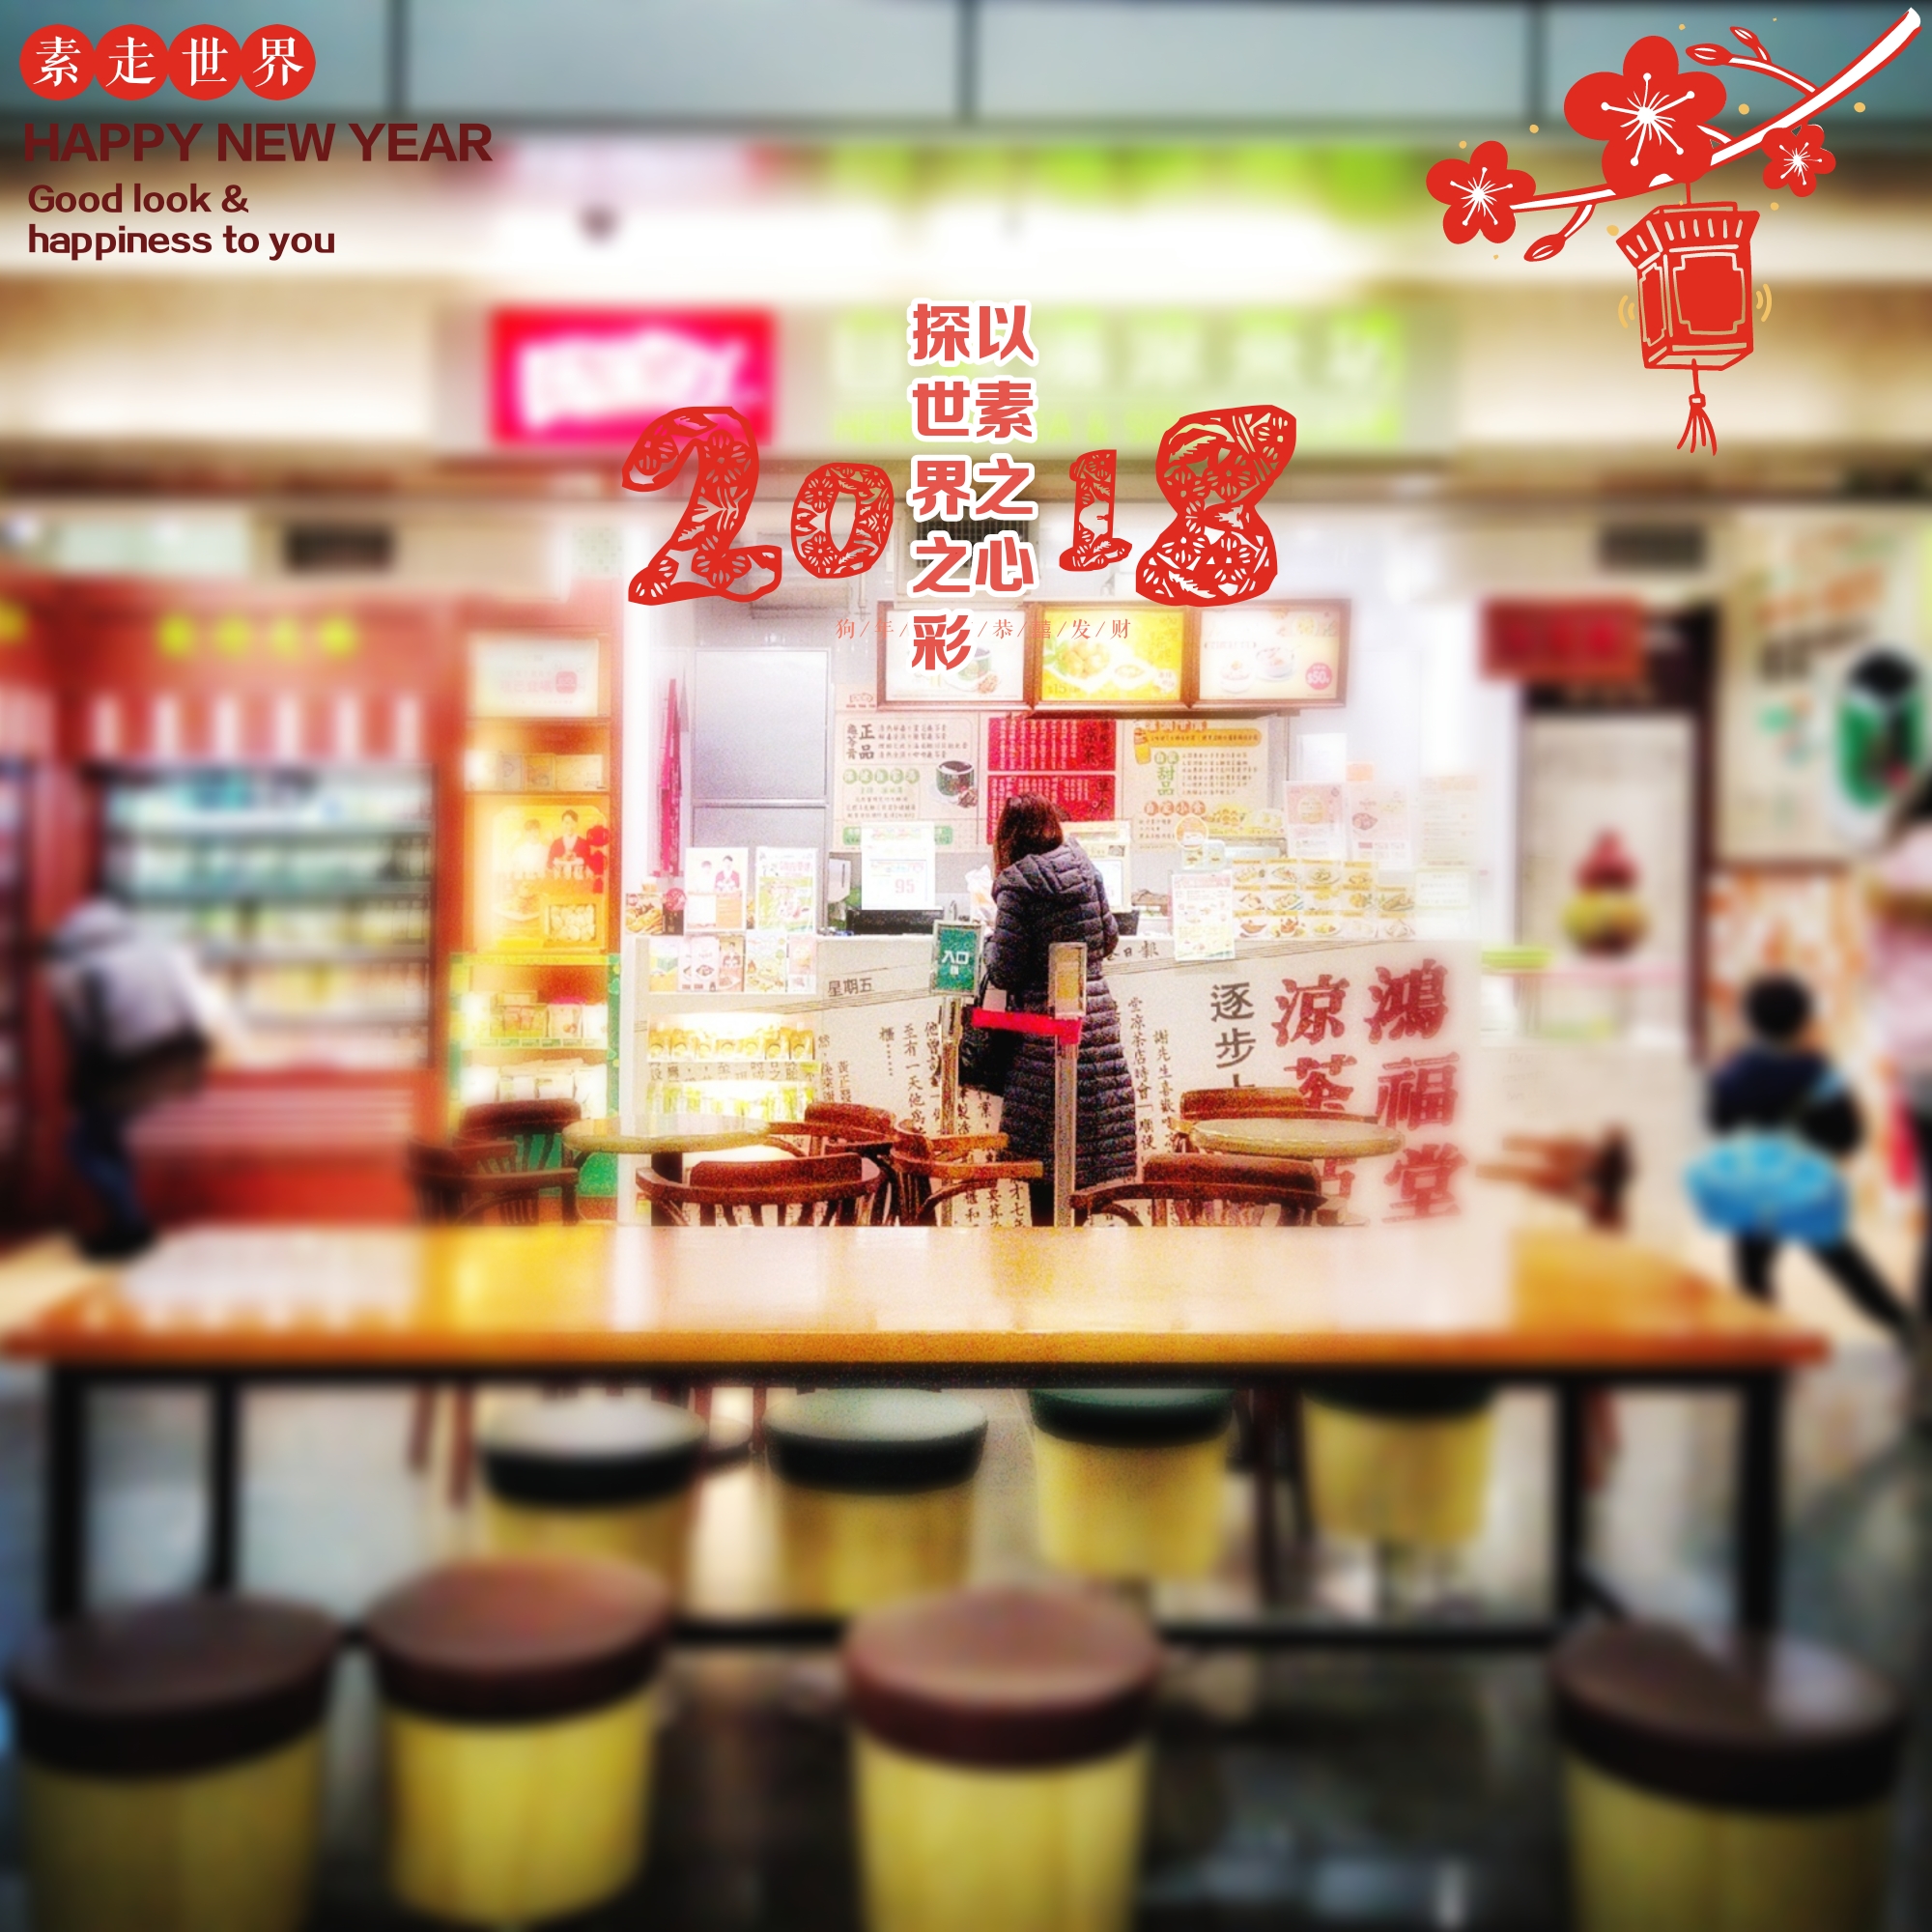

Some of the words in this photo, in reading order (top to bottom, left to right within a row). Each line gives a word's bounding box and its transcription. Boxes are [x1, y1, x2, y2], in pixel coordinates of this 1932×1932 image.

[859, 723, 876, 760] 正品
[943, 950, 976, 969] 入口
[828, 978, 873, 997] 星期五
[1363, 958, 1467, 1222] 鴻福堂
